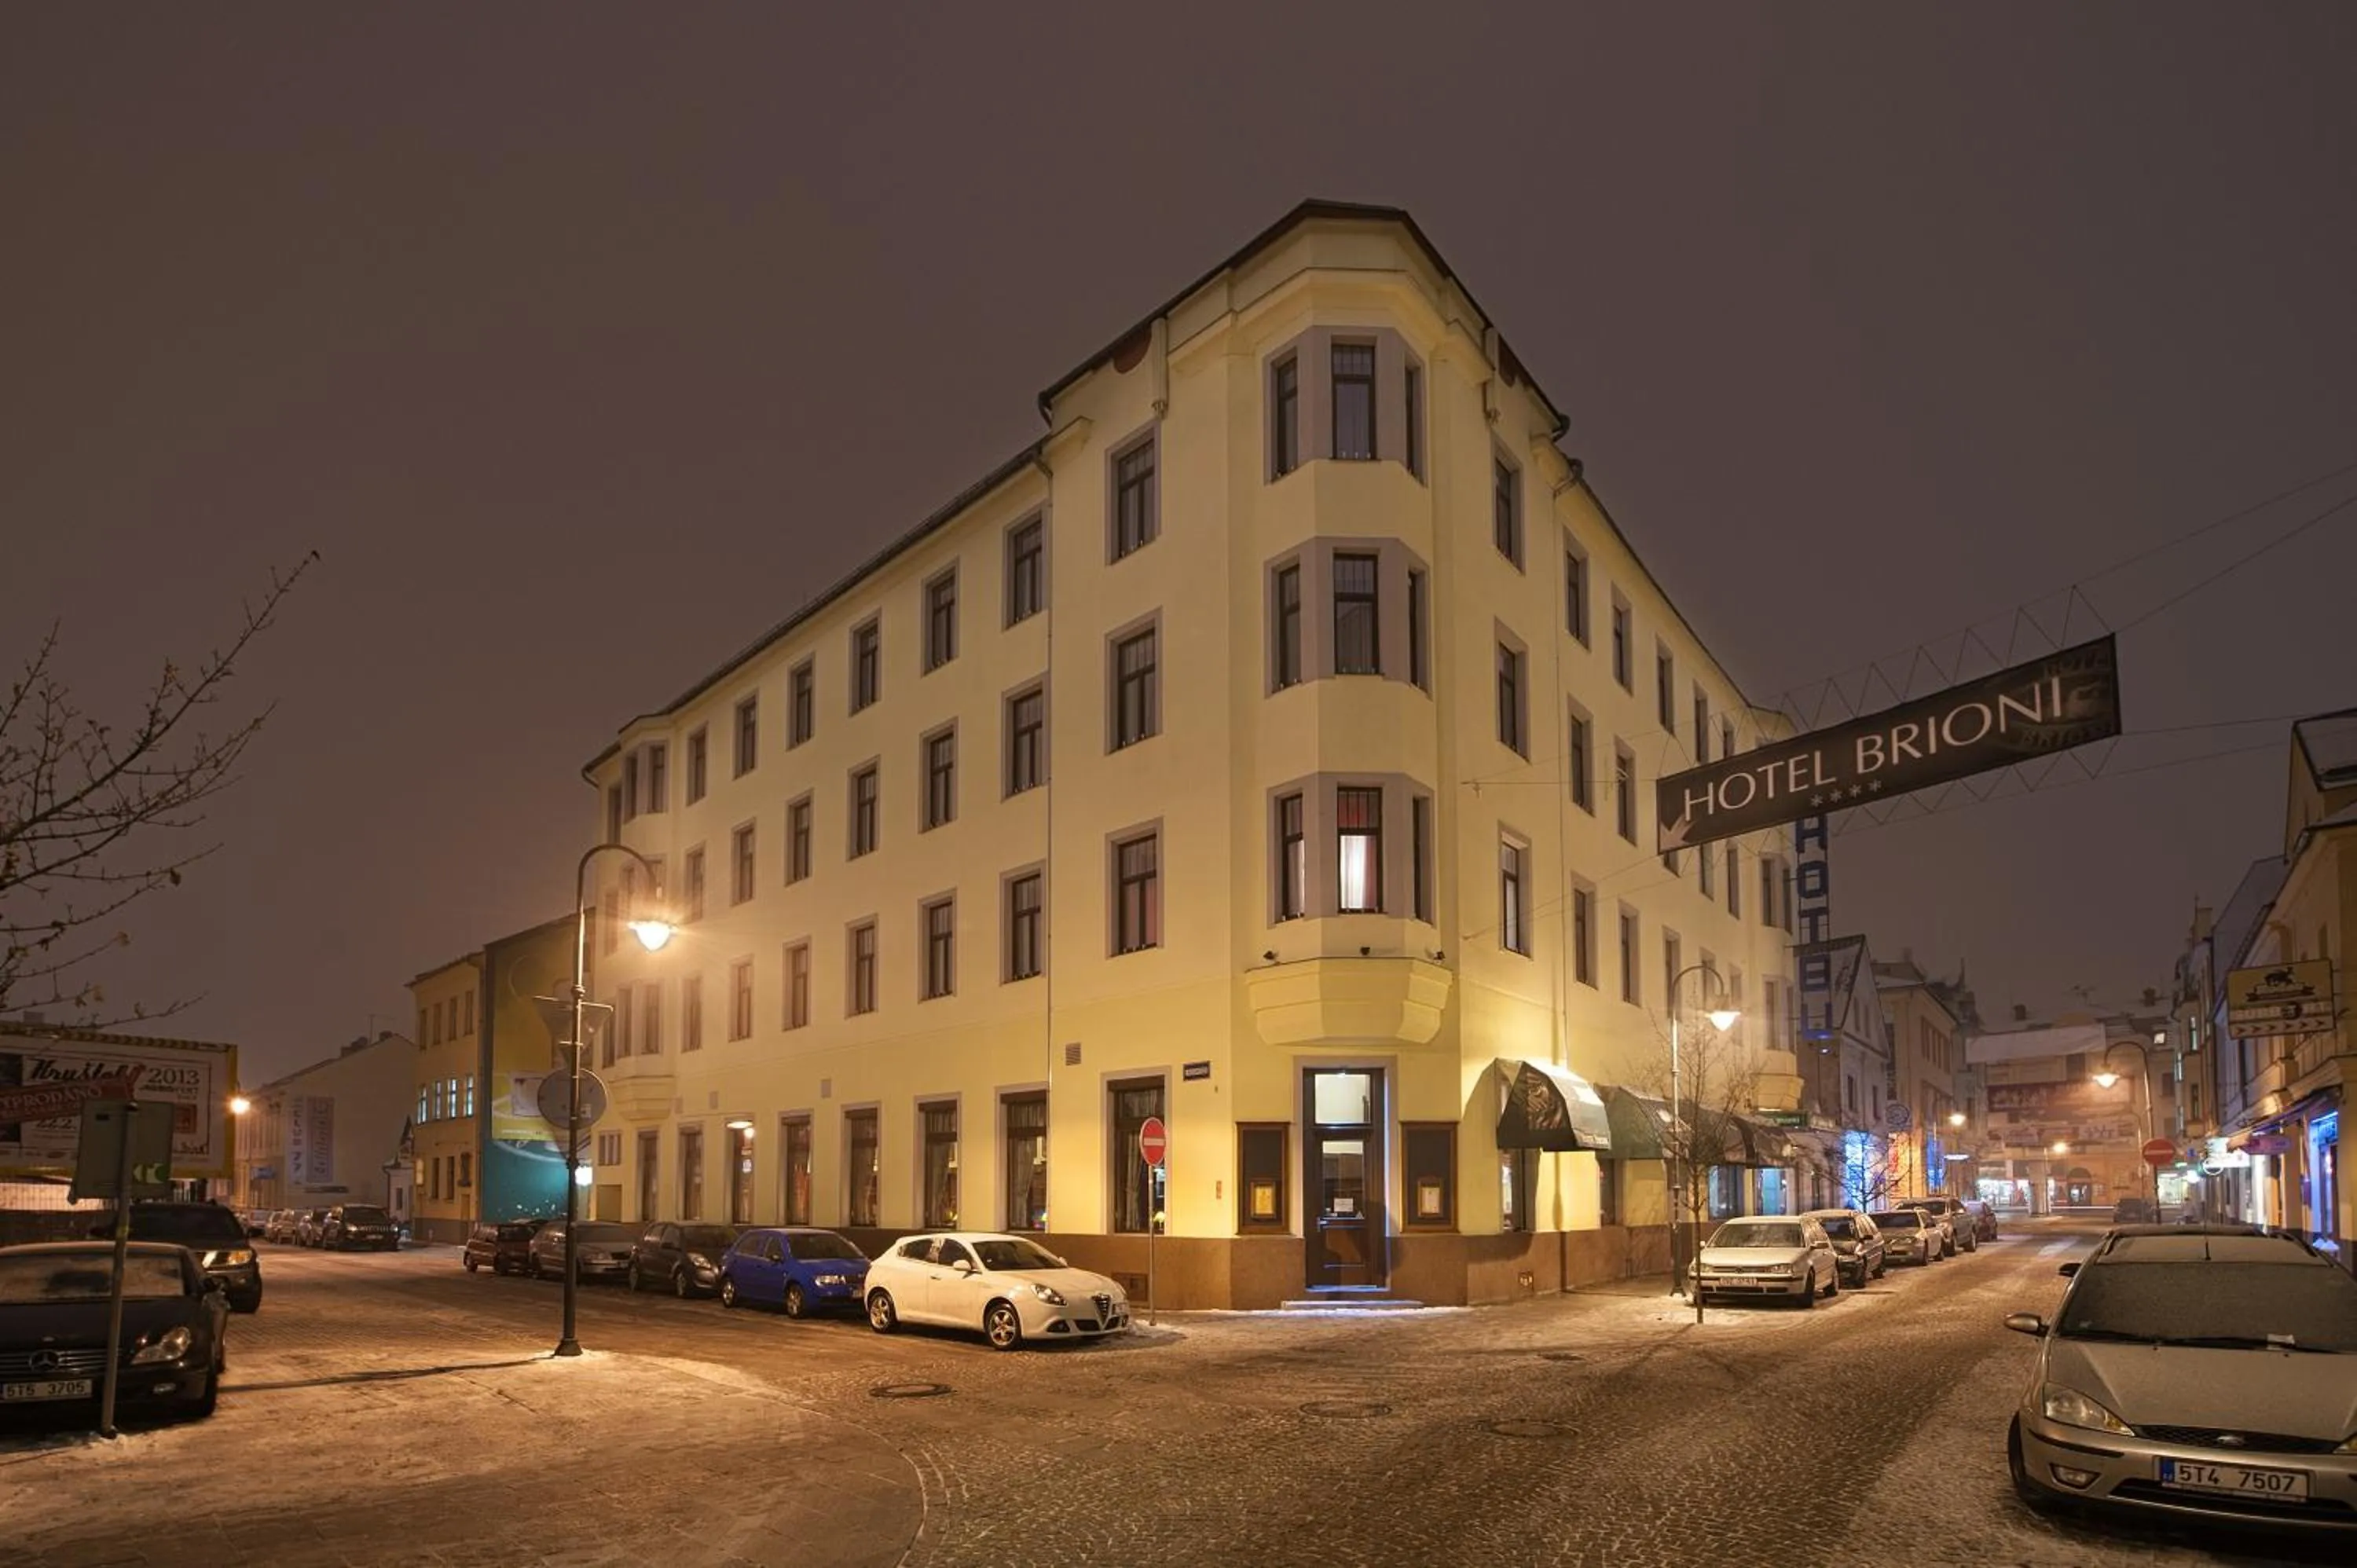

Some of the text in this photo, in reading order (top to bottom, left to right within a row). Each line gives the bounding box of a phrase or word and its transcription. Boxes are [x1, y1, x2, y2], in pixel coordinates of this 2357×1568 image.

[1684, 676, 2062, 822] HOTEL BRIONI
[1795, 812, 1834, 1040] HOTEL
[148, 1068, 200, 1084] 2013
[7, 1381, 85, 1397] 5T5 3705
[2179, 1465, 2295, 1493] 5T4 7507
